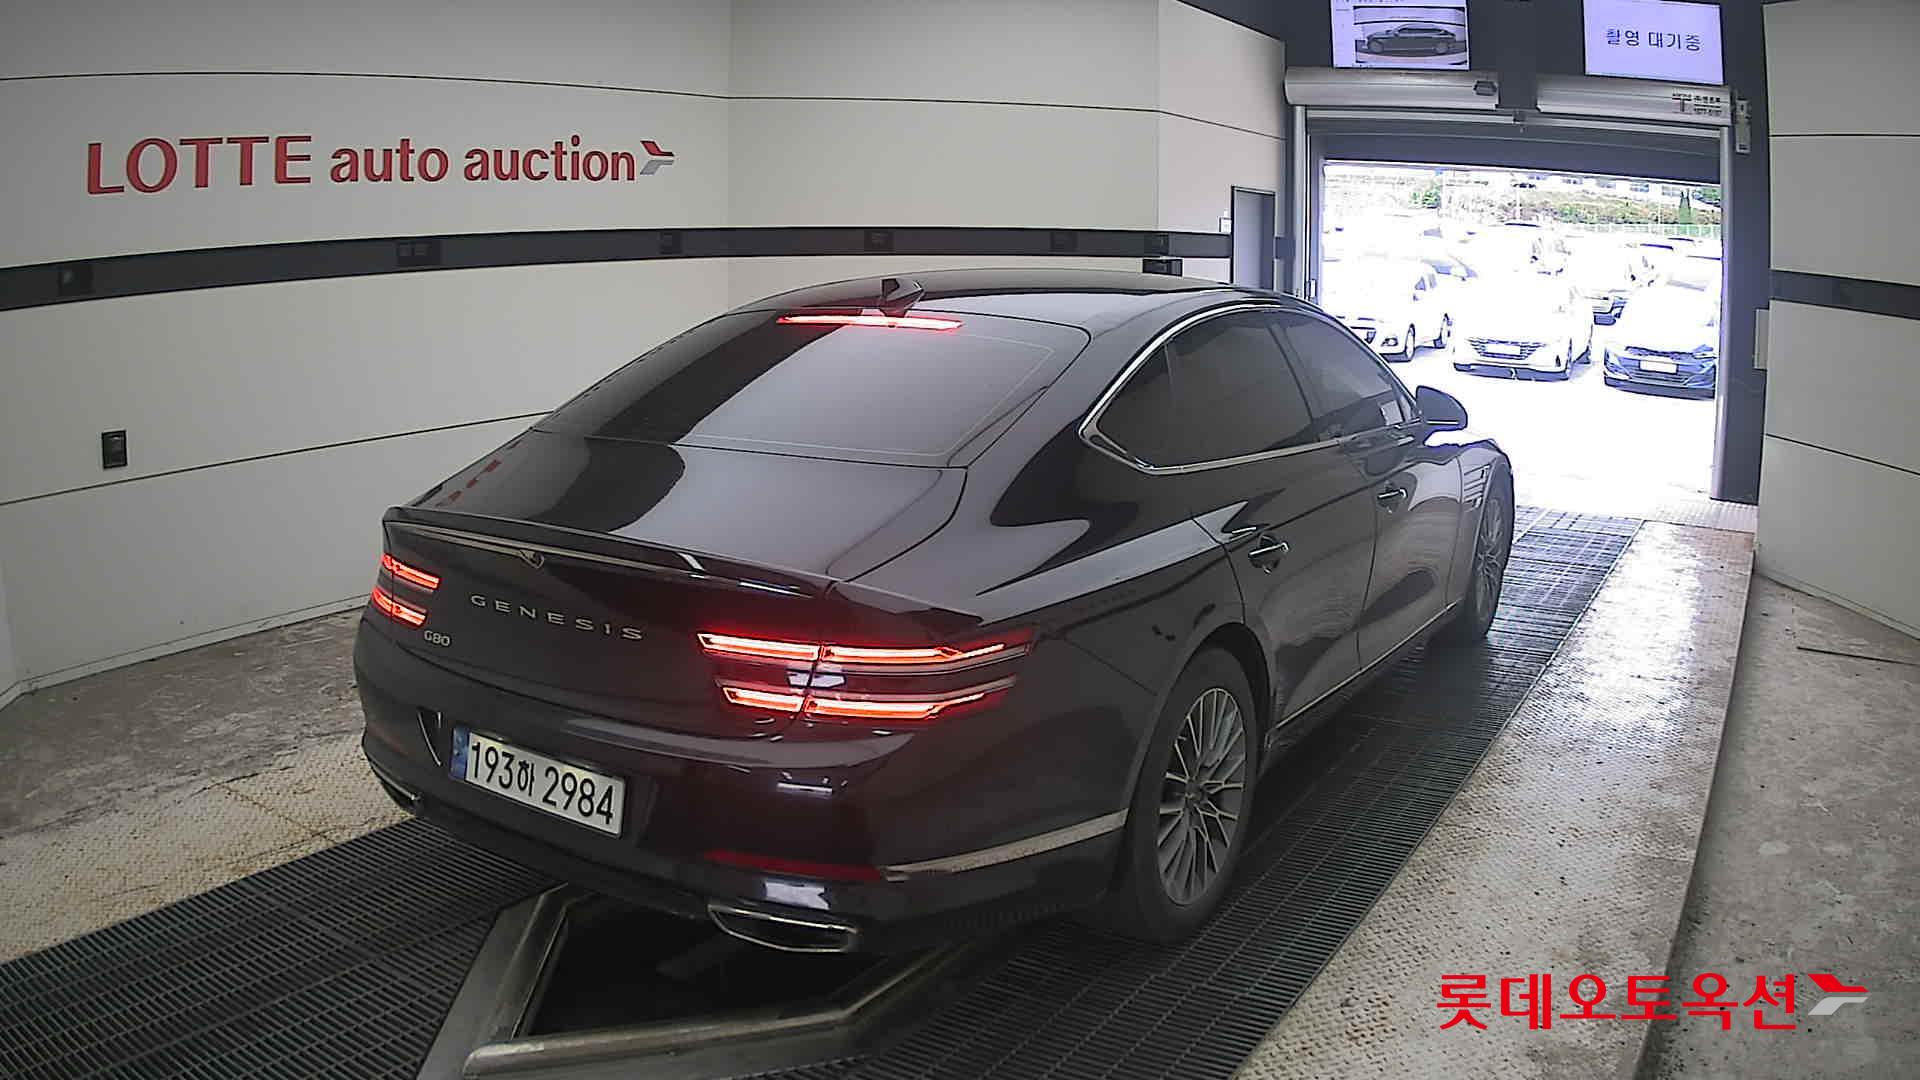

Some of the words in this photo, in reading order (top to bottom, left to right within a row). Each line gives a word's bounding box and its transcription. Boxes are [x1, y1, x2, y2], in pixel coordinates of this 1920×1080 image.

[1607, 28, 1640, 47] 촬영
[1648, 31, 1701, 51] 대기중
[87, 135, 312, 194] LOTTE
[329, 138, 449, 183] auto
[463, 134, 636, 182] auction
[424, 630, 451, 647] G80
[470, 594, 643, 641] GENESIS
[471, 741, 535, 797] 193하
[542, 766, 614, 825] 2984
